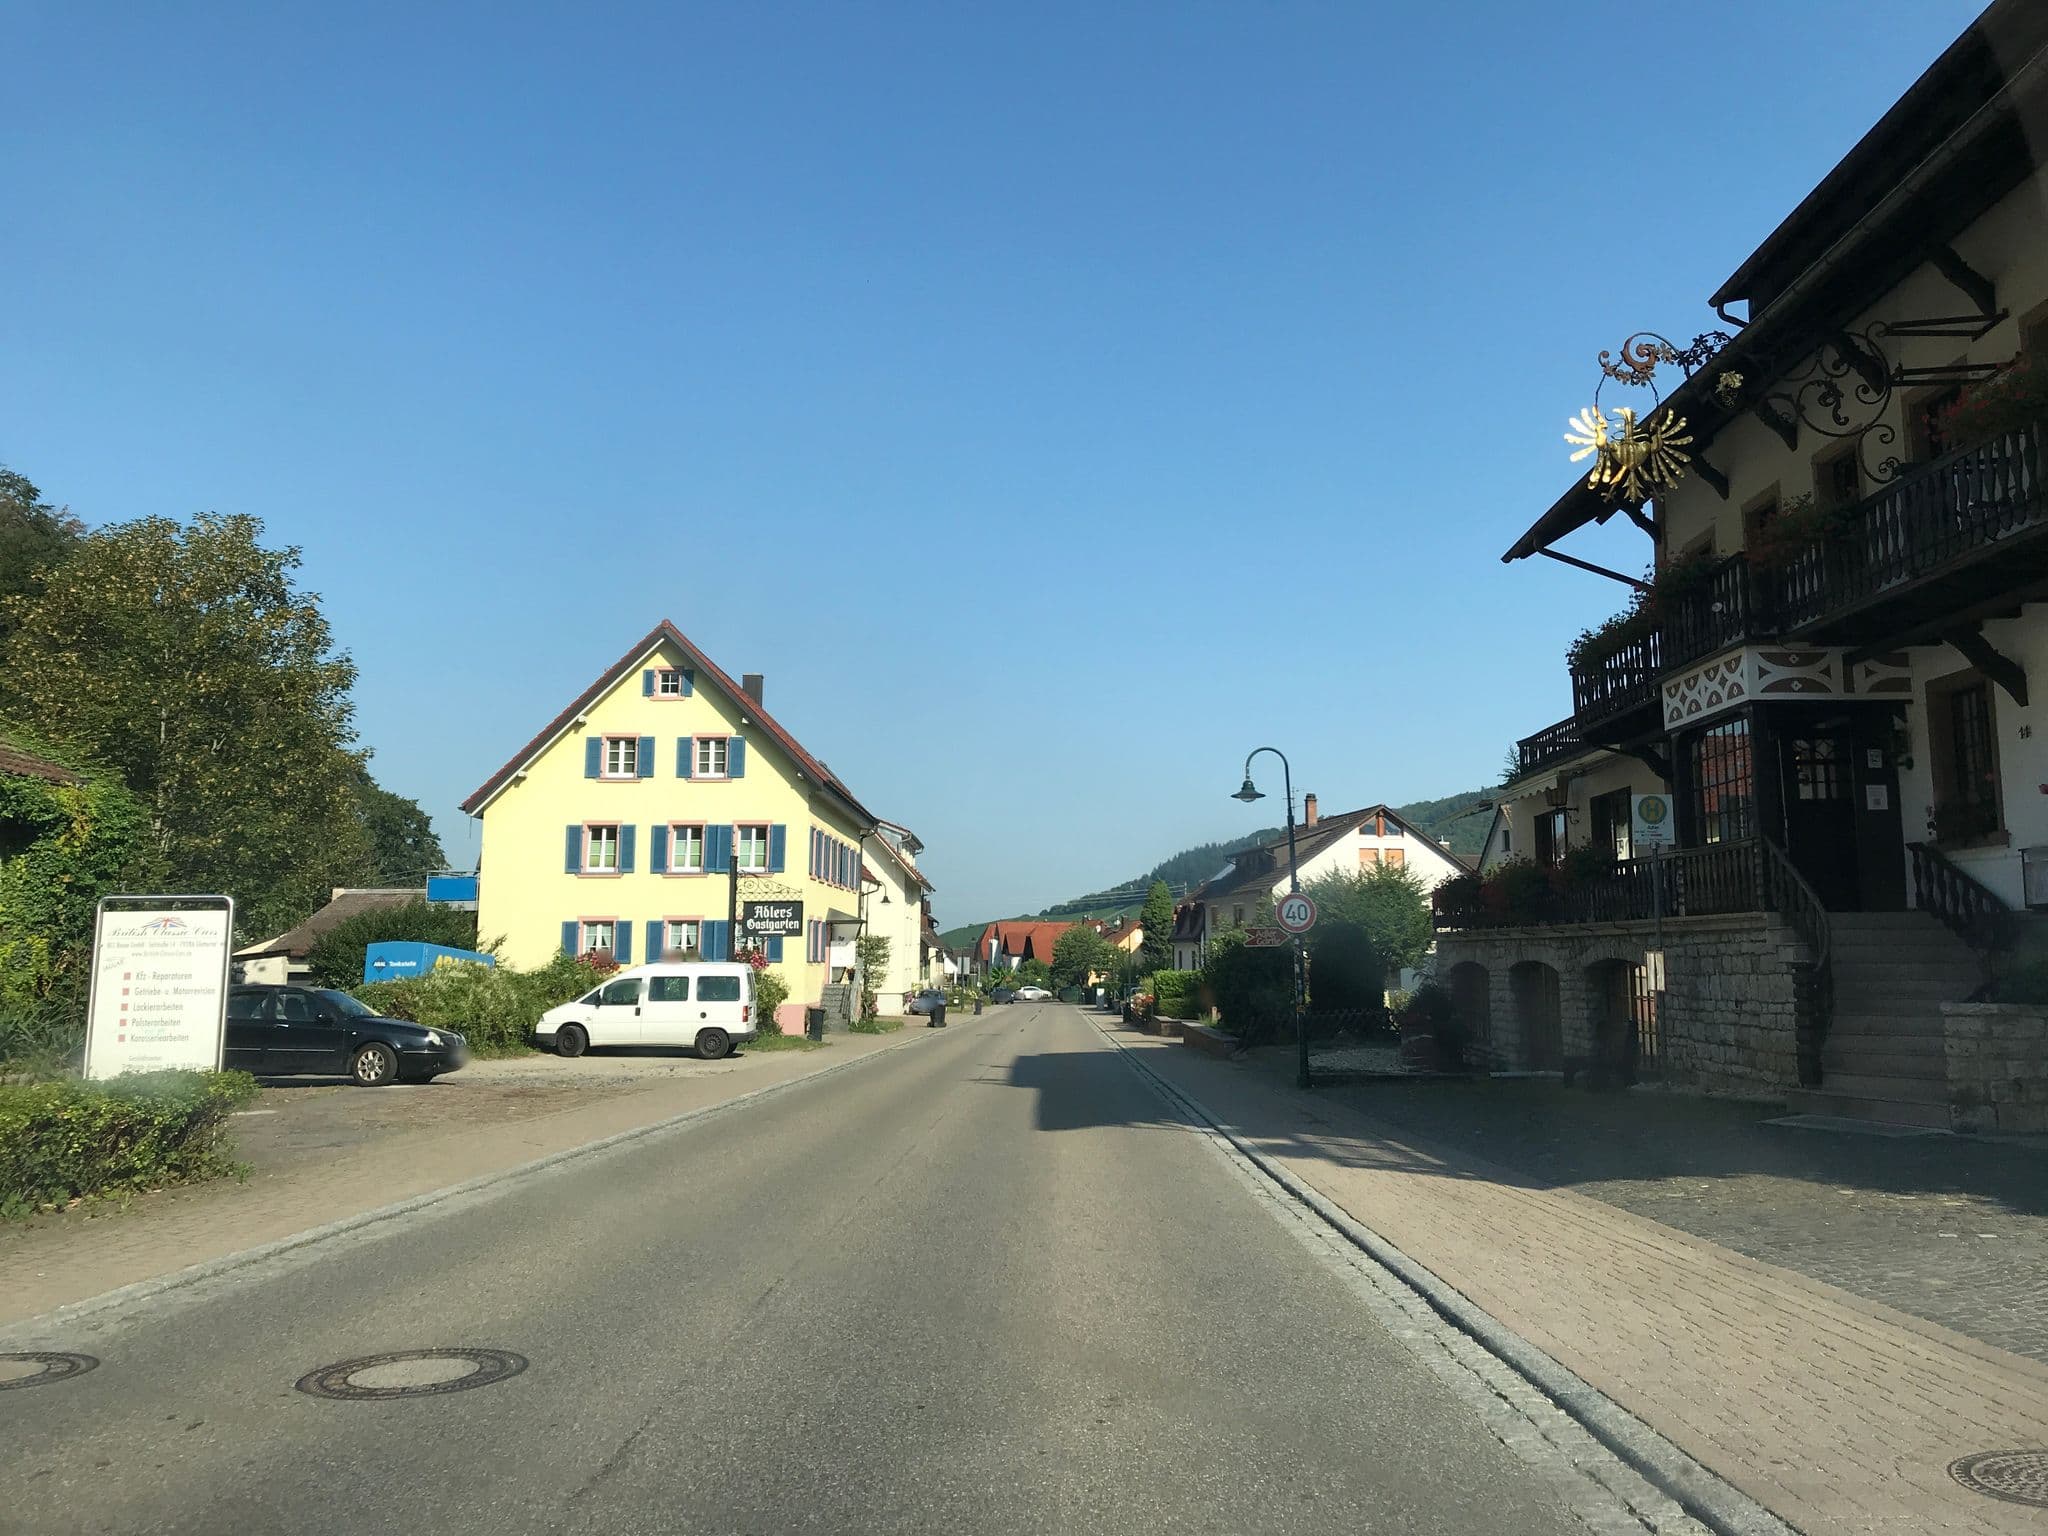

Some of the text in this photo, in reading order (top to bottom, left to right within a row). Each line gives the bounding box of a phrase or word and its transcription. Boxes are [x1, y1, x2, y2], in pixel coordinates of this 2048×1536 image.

[753, 905, 793, 919] Adlers
[1285, 903, 1308, 921] 40
[746, 918, 800, 931] Gastgarten
[110, 927, 218, 937] British Classic Cars
[152, 971, 193, 981] Reparaturen
[134, 987, 161, 996] Getriebe
[133, 1002, 184, 1012] Lackierarbeiten
[131, 1018, 181, 1027] Polsterarbeiten
